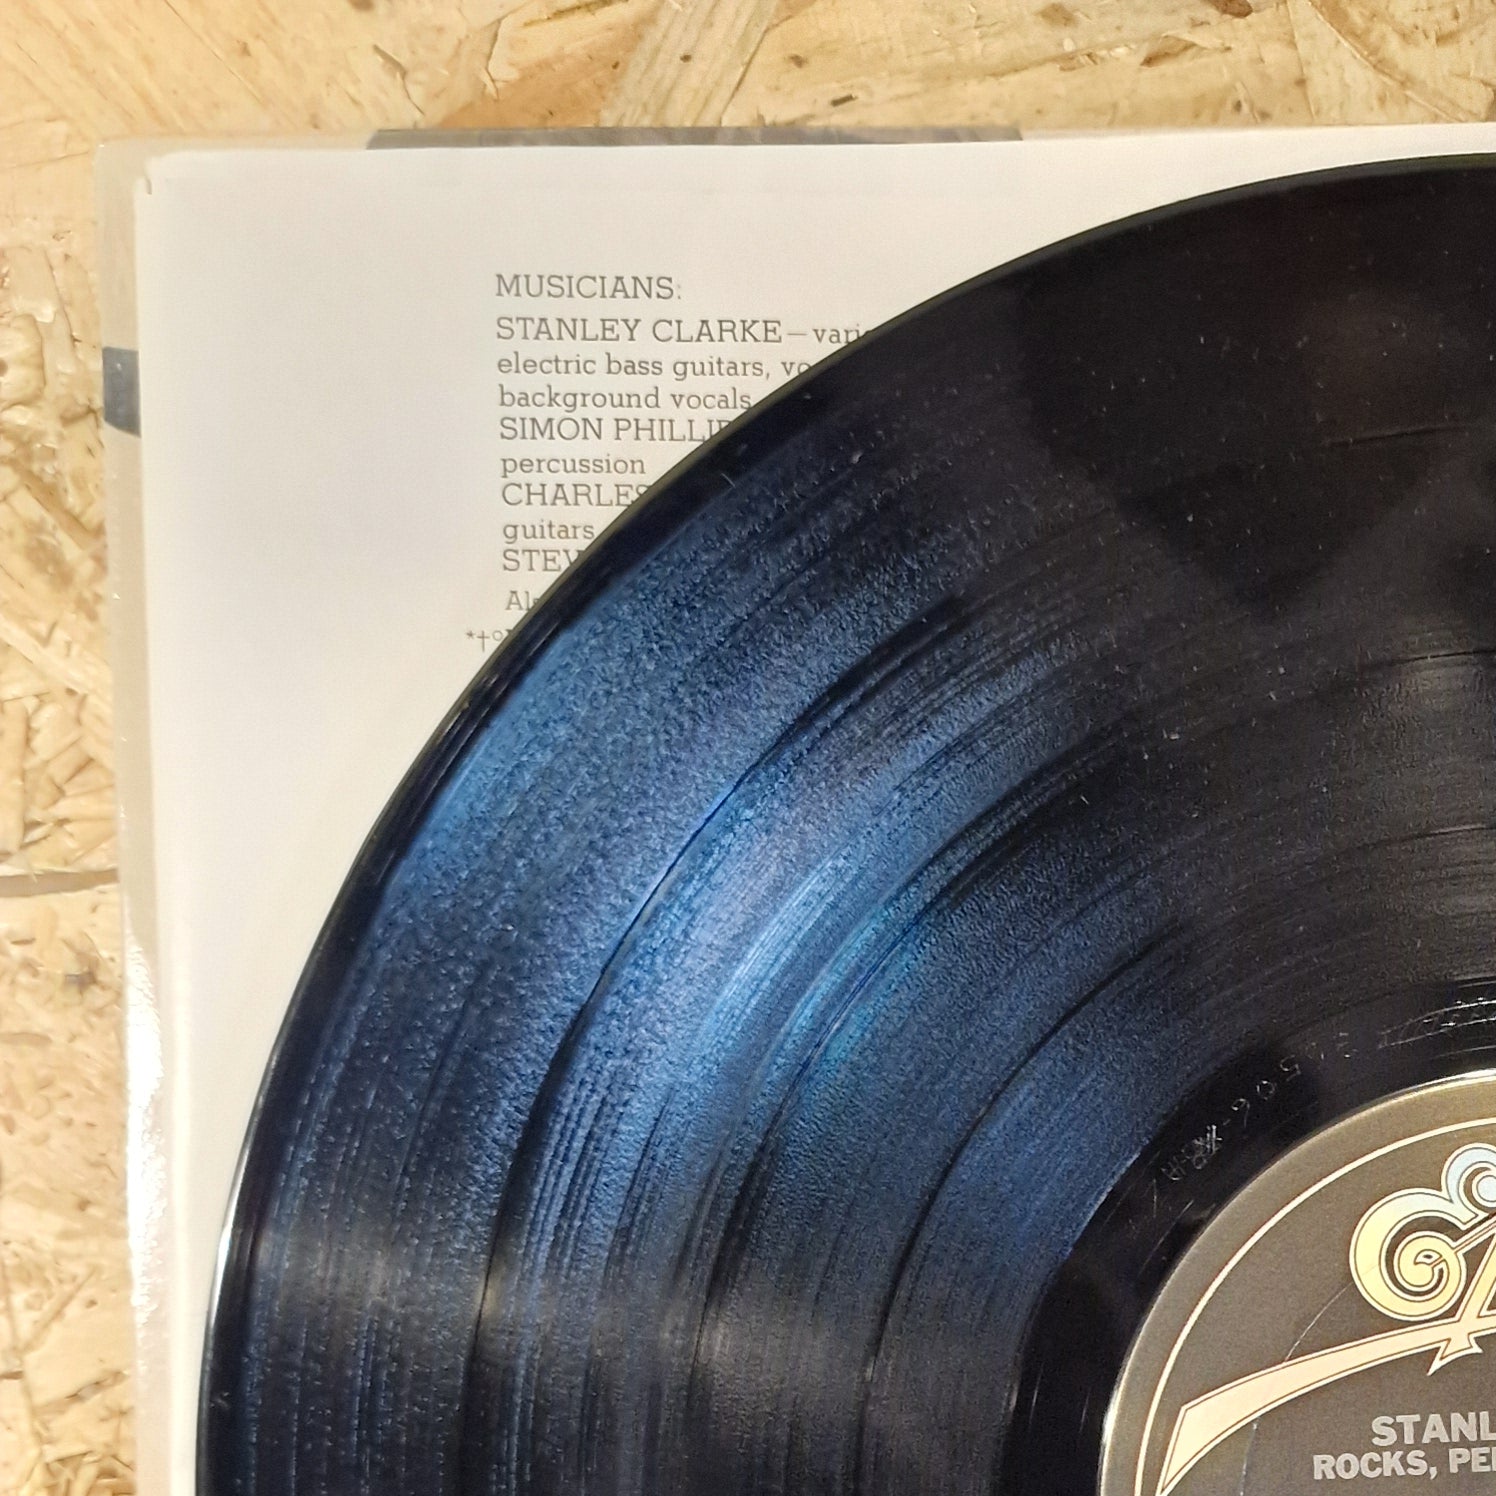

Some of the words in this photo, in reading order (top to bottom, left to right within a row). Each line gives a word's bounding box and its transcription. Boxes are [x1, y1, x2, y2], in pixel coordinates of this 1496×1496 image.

[495, 274, 682, 299] MUSICIANS:
[496, 317, 641, 341] STANLEY
[652, 319, 782, 343] CLARKE
[813, 324, 870, 344] vari
[498, 353, 596, 375] electric
[606, 354, 664, 376] bass
[673, 356, 771, 382] guitars,
[499, 385, 660, 412] background
[499, 418, 604, 441] SIMON
[500, 454, 647, 479] percussion
[502, 519, 596, 545] guitars
[502, 549, 583, 573] STEV
[1312, 1449, 1438, 1481] ROCKS,
